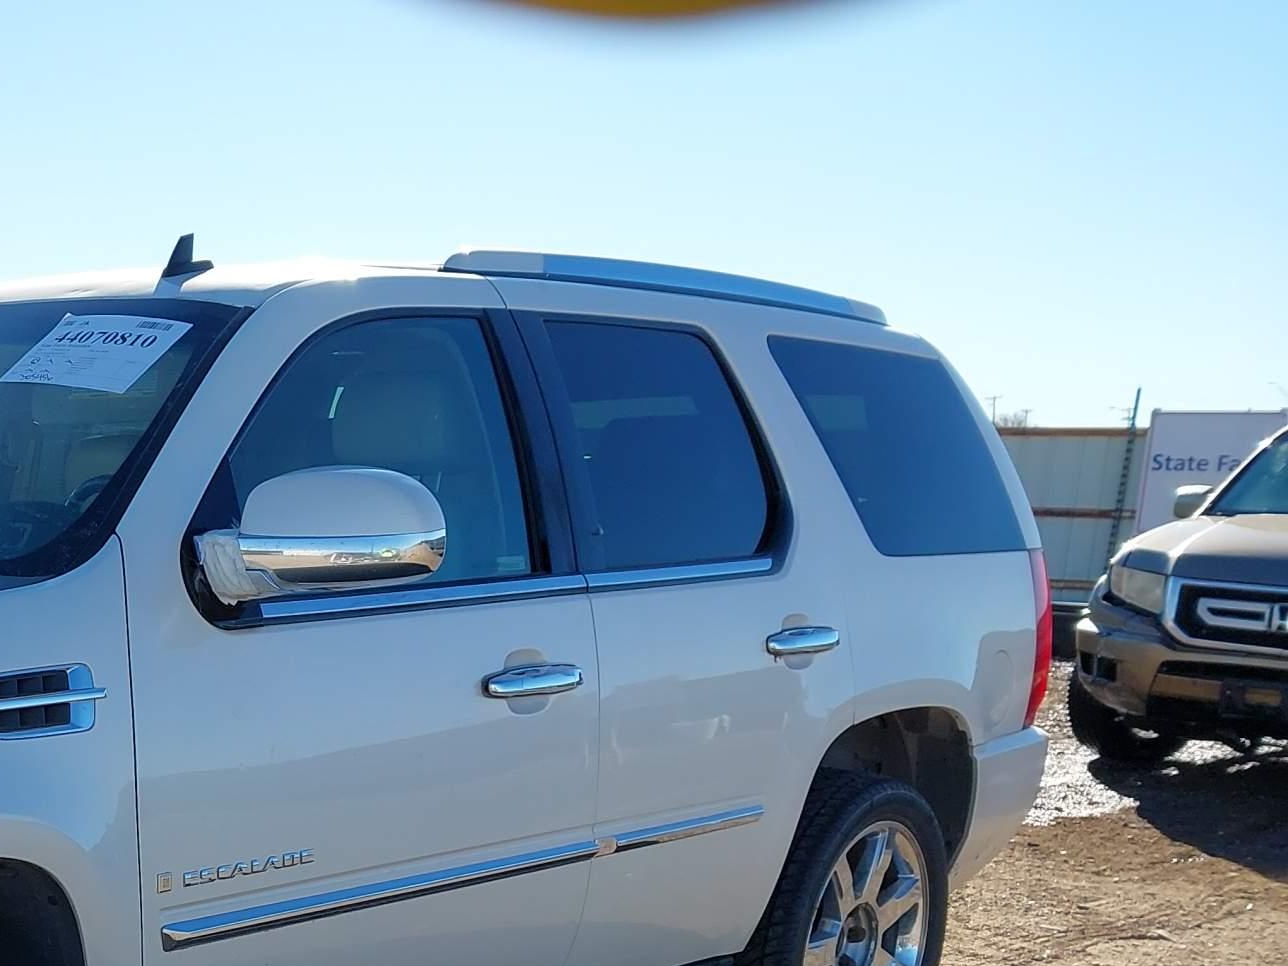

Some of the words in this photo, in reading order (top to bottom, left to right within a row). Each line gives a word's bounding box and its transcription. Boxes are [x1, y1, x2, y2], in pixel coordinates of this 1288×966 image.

[54, 330, 159, 348] 44070810
[1152, 453, 1209, 472] State
[183, 848, 314, 888] ESCALADE
